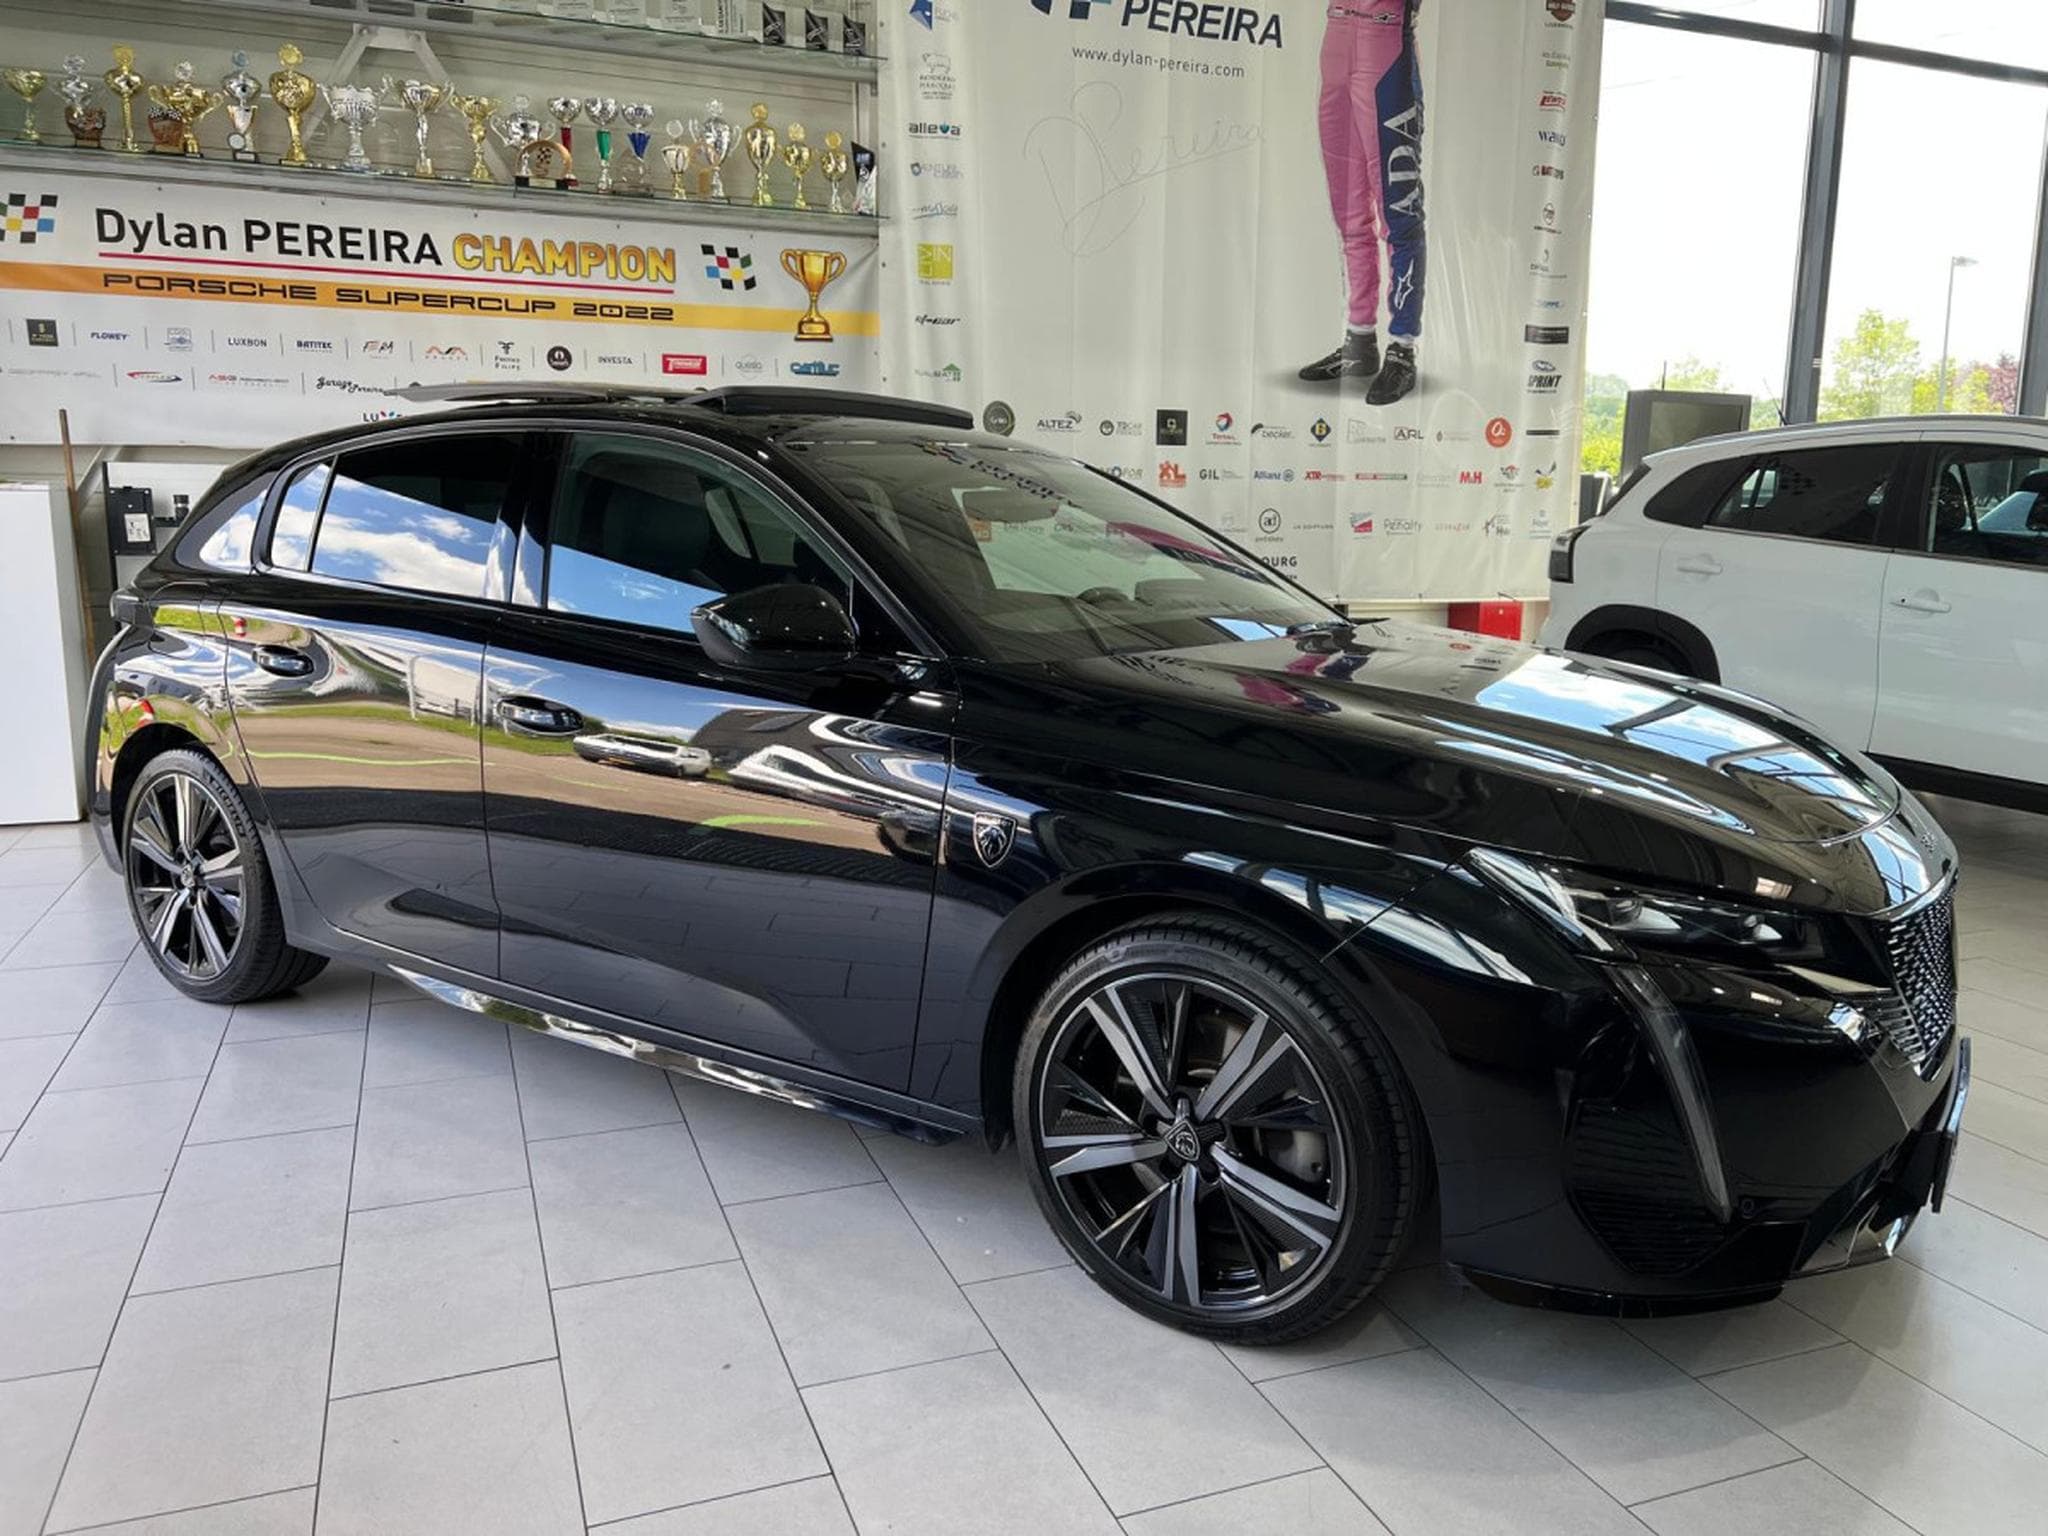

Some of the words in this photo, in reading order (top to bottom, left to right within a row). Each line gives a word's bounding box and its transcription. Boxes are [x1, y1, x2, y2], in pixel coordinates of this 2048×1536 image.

[1121, 0, 1283, 48] PEREIRA
[1072, 47, 1245, 78] www.dylan-pereira.com
[96, 207, 228, 253] Dylan
[244, 219, 443, 266] PEREIRA
[452, 233, 676, 283] CHAMPION
[103, 273, 317, 301] PORSCHE
[336, 288, 556, 313] SUPERCUP
[572, 302, 675, 321] 2022
[1036, 418, 1073, 430] ALTEZ
[1199, 468, 1220, 480] GIL
[1253, 469, 1282, 481] Allianz
